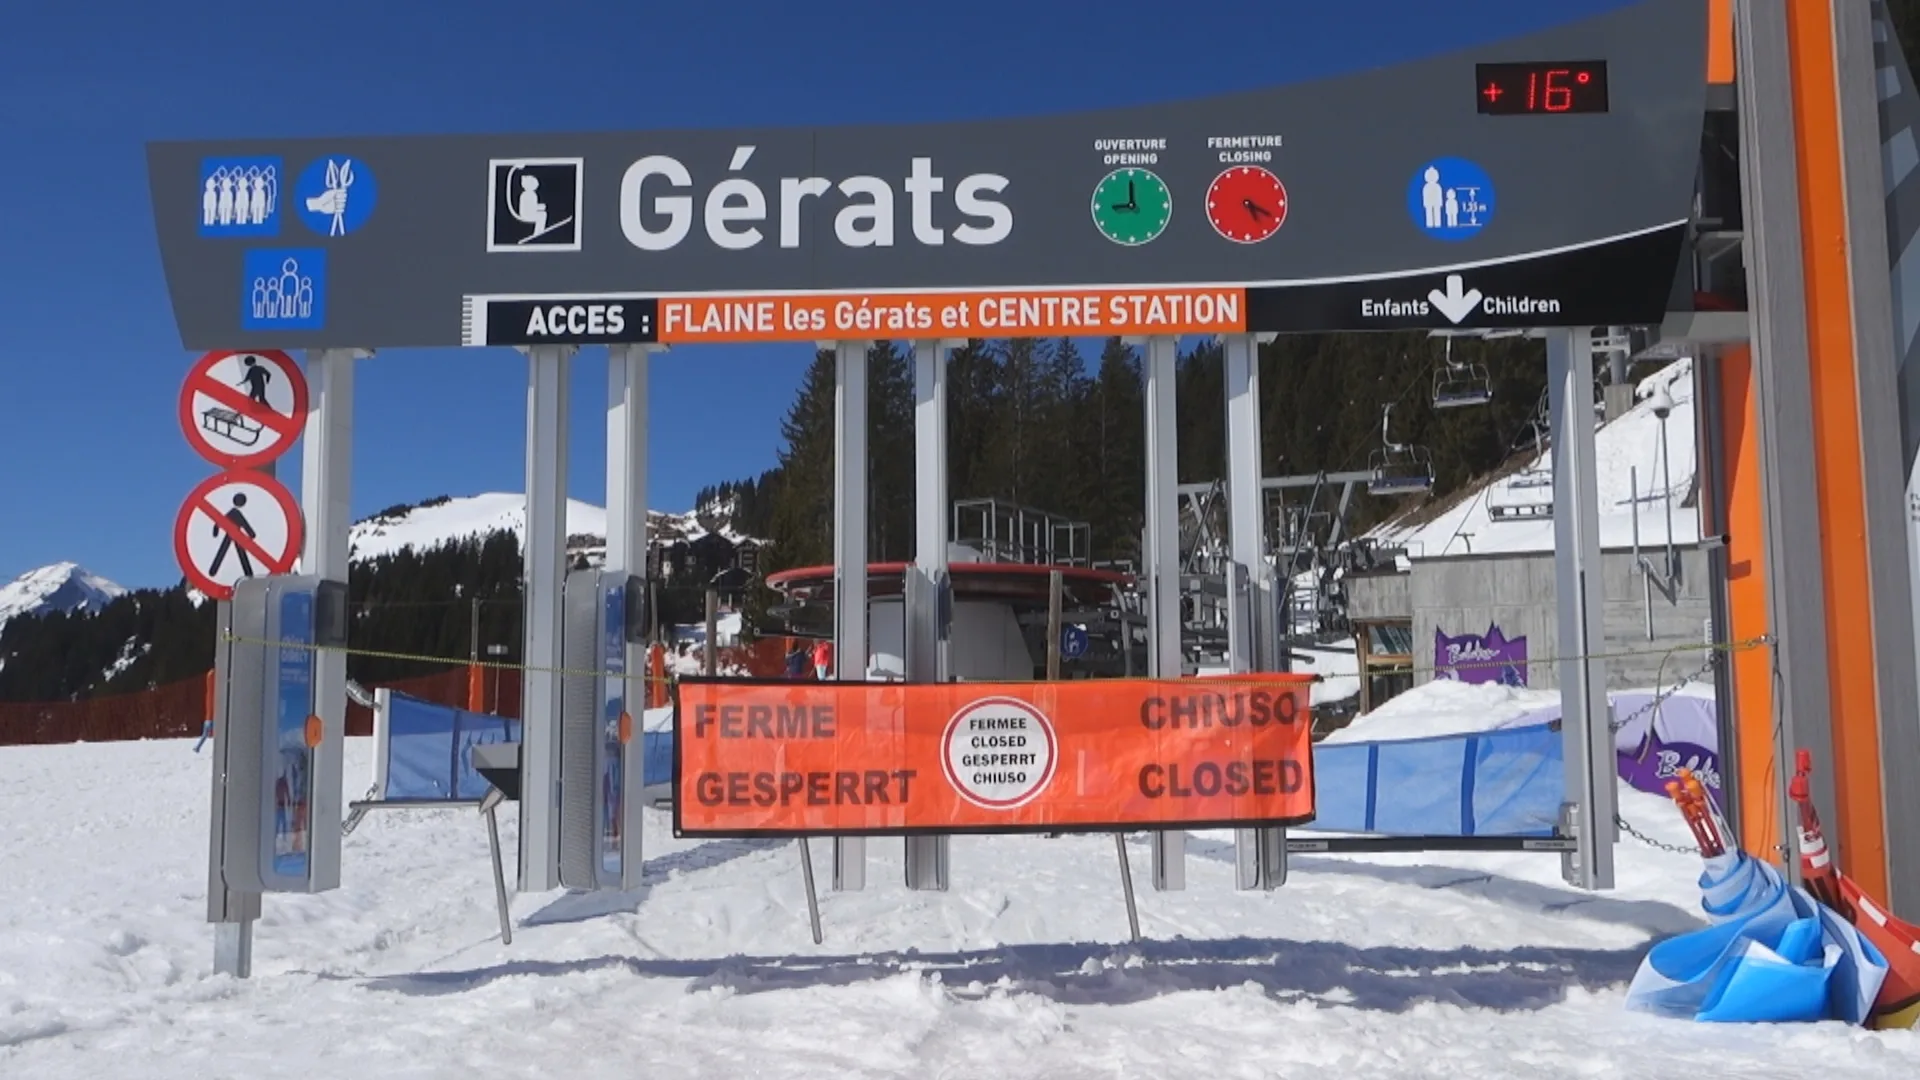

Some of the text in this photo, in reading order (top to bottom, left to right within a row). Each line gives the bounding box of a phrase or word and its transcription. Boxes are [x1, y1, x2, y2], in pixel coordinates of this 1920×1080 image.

[1094, 138, 1167, 151] OUVERTURE
[1207, 135, 1282, 149] FERMETURE
[1103, 153, 1158, 165] OPENING
[1218, 151, 1272, 163] CLOSING
[619, 145, 1014, 251] Gérats
[1361, 300, 1429, 316] Enfants
[1483, 297, 1561, 314] Children
[526, 305, 625, 336] ACCES
[665, 303, 775, 333] FLAINE
[783, 301, 826, 330] les
[833, 298, 932, 330] Gérats
[940, 301, 969, 329] et
[978, 297, 1101, 327] CENTRE
[1109, 294, 1238, 325] STATION
[1140, 691, 1303, 730] CHIUSO
[695, 704, 836, 739] FERME
[970, 718, 1027, 730] FERMEE
[971, 736, 1026, 748] CLOSED
[962, 754, 1036, 767] GESPERRT
[973, 772, 1026, 785] CHIUSO
[1138, 759, 1303, 799] CLOSED
[697, 770, 917, 807] GESPERRT
